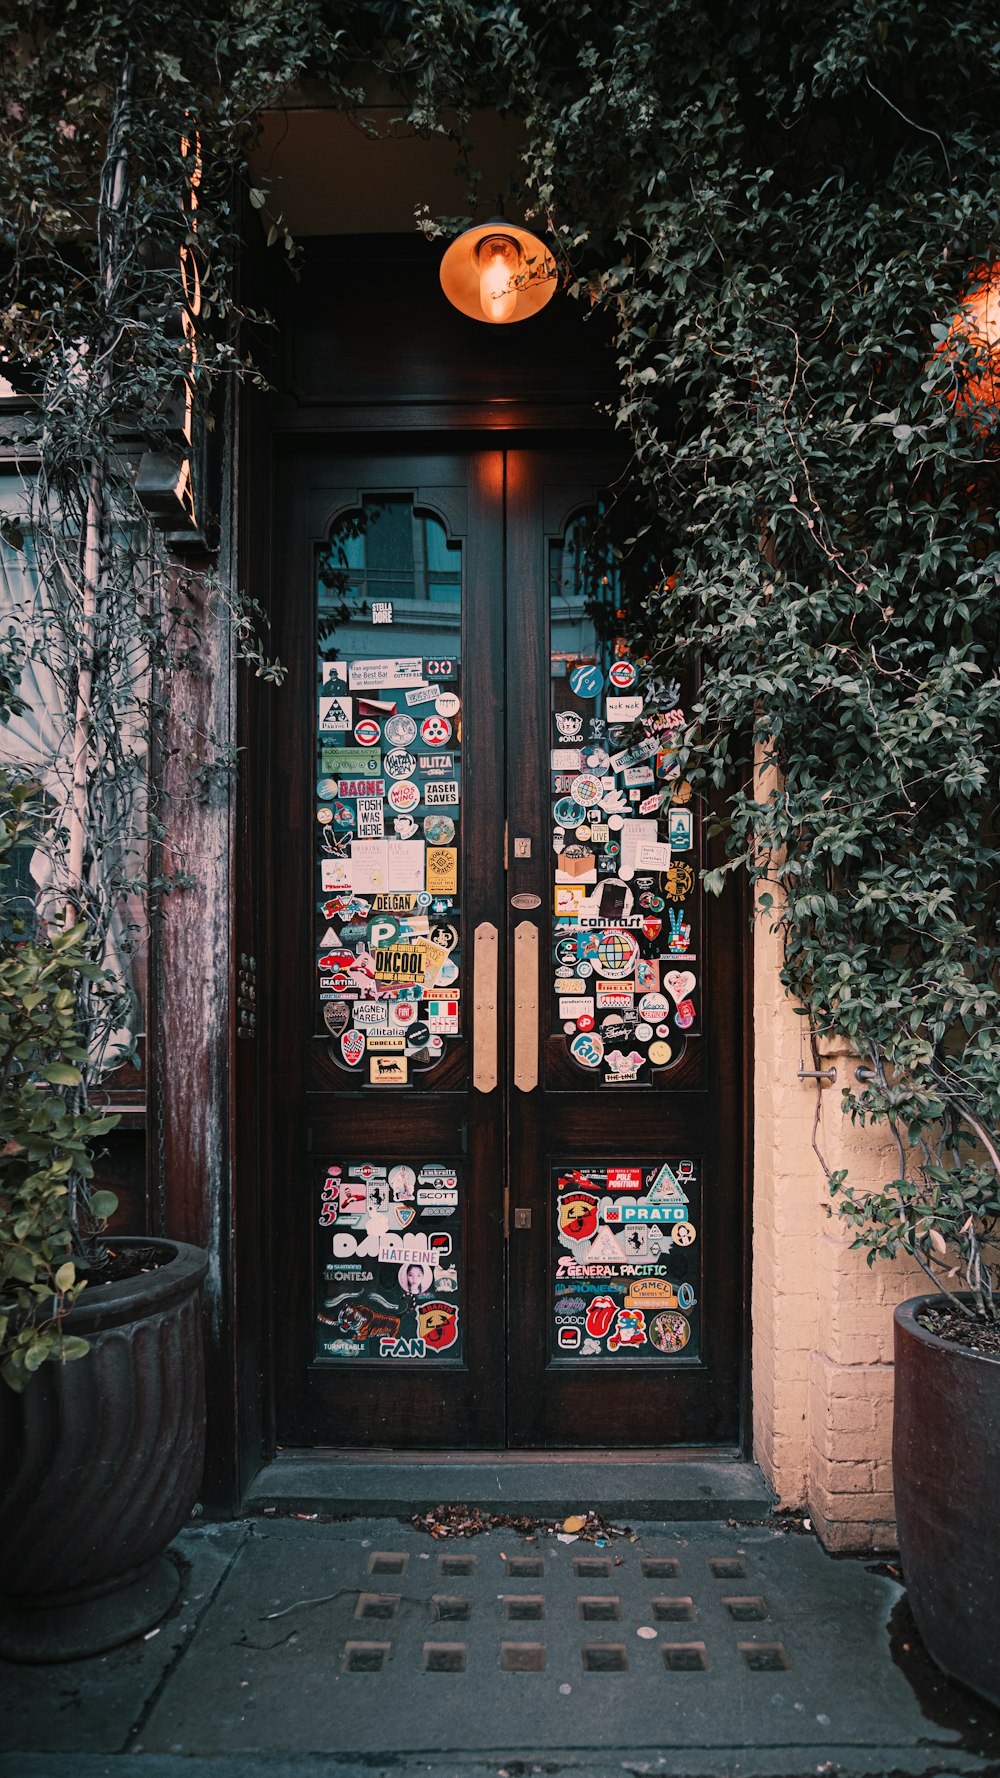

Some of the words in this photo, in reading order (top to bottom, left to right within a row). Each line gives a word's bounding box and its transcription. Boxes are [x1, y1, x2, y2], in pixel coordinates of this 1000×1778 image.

[372, 602, 392, 611] STELLA
[372, 611, 392, 624] DORE
[609, 702, 622, 710] NOK
[625, 701, 640, 709] NOK
[369, 760, 376, 769] 5
[420, 756, 452, 769] ULITZA
[427, 784, 456, 793] ZASEH
[427, 794, 456, 803] SAVES
[358, 800, 382, 811] FOSH
[361, 812, 380, 823] WAS
[360, 824, 382, 836] HERE
[592, 832, 608, 842] LIVE
[666, 893, 686, 903] PUB
[371, 923, 396, 948] P
[376, 951, 425, 974] OKCOOL
[598, 982, 633, 991] PIRELLI
[423, 990, 458, 998] PIRELLI
[601, 995, 632, 1003] FERODO
[398, 1007, 410, 1016] FIAT
[367, 1027, 405, 1036] Alitalia
[615, 1173, 632, 1181] POLE
[321, 1178, 341, 1201] 5
[563, 1194, 596, 1205] ABARTH
[318, 1202, 339, 1227] 5
[625, 1208, 685, 1220] PRATO
[567, 1265, 619, 1277] GENERAL
[620, 1264, 668, 1277] PACIFIC
[633, 1281, 670, 1293] CAMEL
[421, 1303, 454, 1314] ABARTH
[323, 1343, 365, 1351] TURNTEABLE
[380, 1338, 426, 1358] FAN
